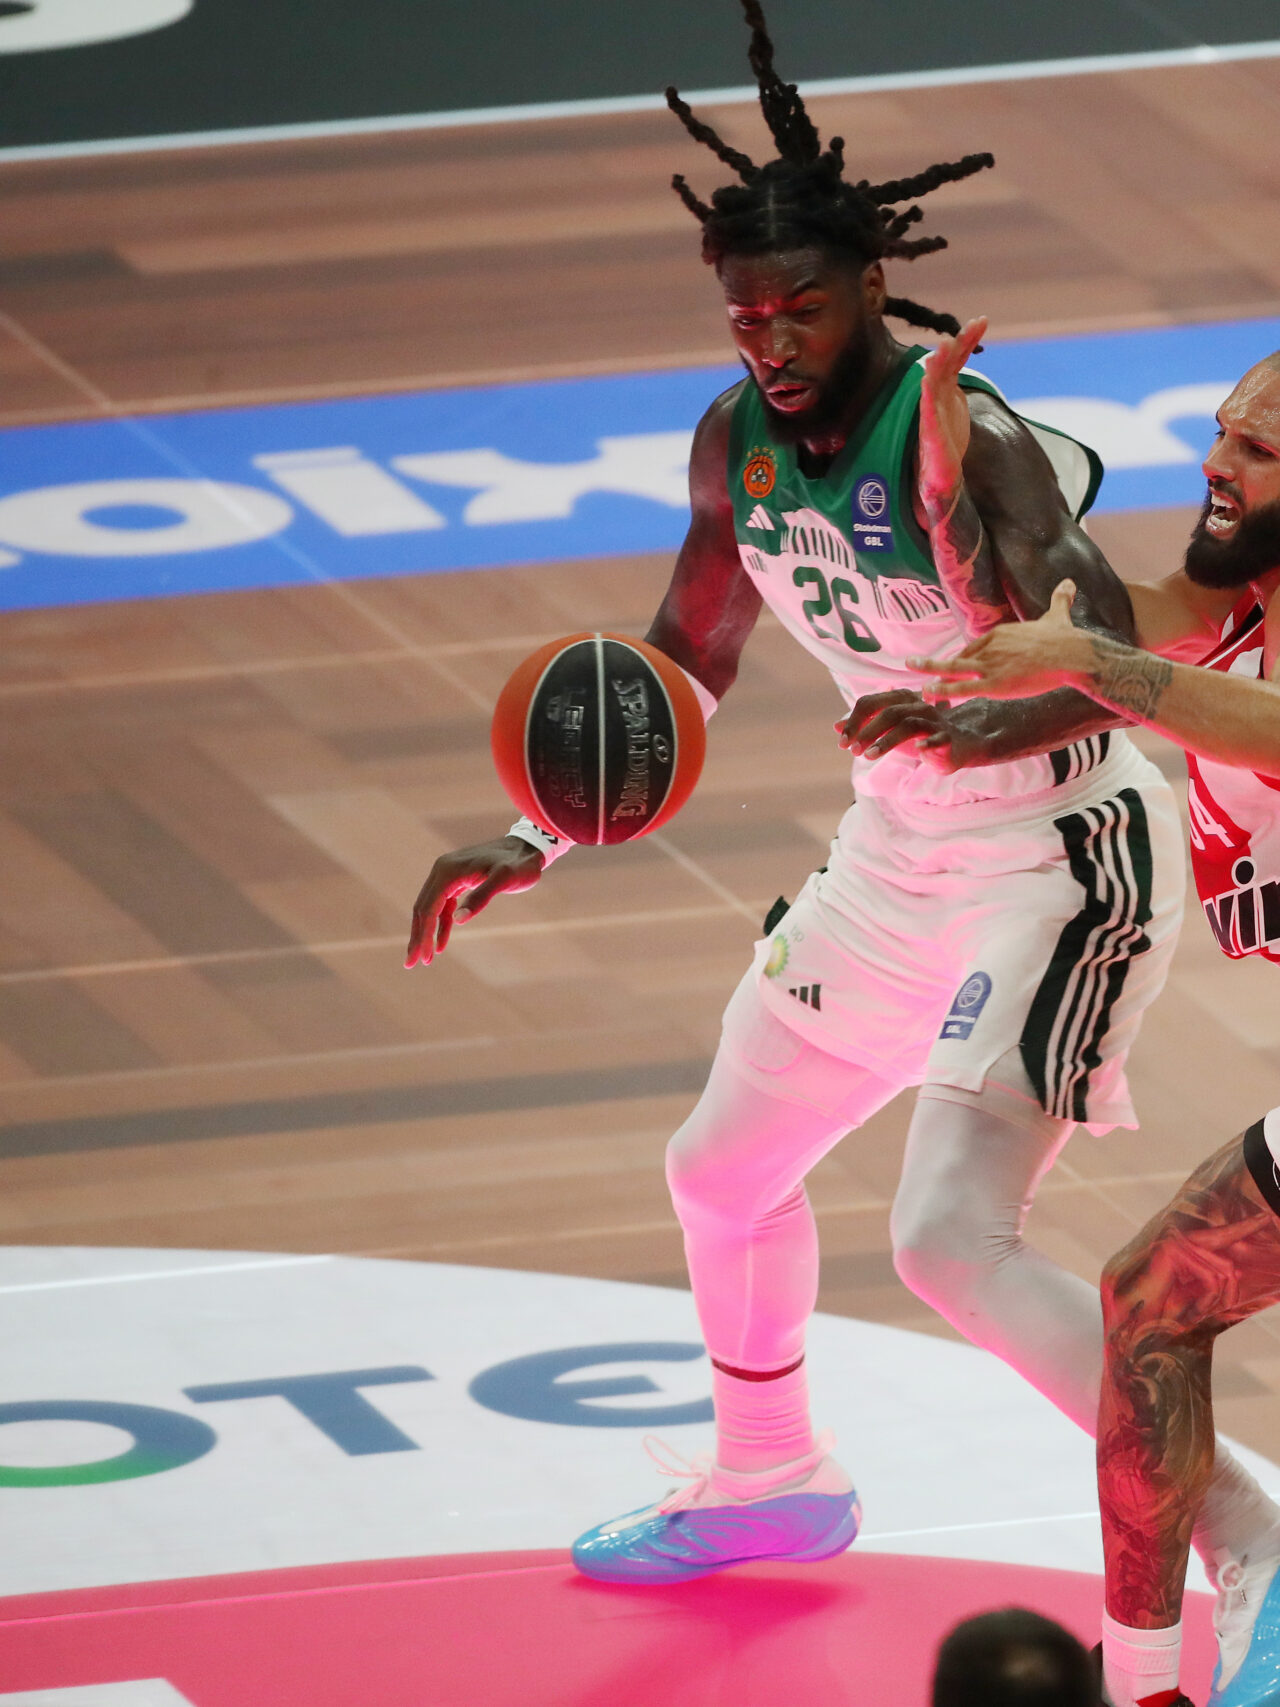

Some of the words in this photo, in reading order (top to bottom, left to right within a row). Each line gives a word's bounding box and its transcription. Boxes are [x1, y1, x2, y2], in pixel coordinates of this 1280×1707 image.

[864, 536, 884, 546] GBL
[792, 566, 881, 653] 26
[611, 679, 650, 821] SPALDING
